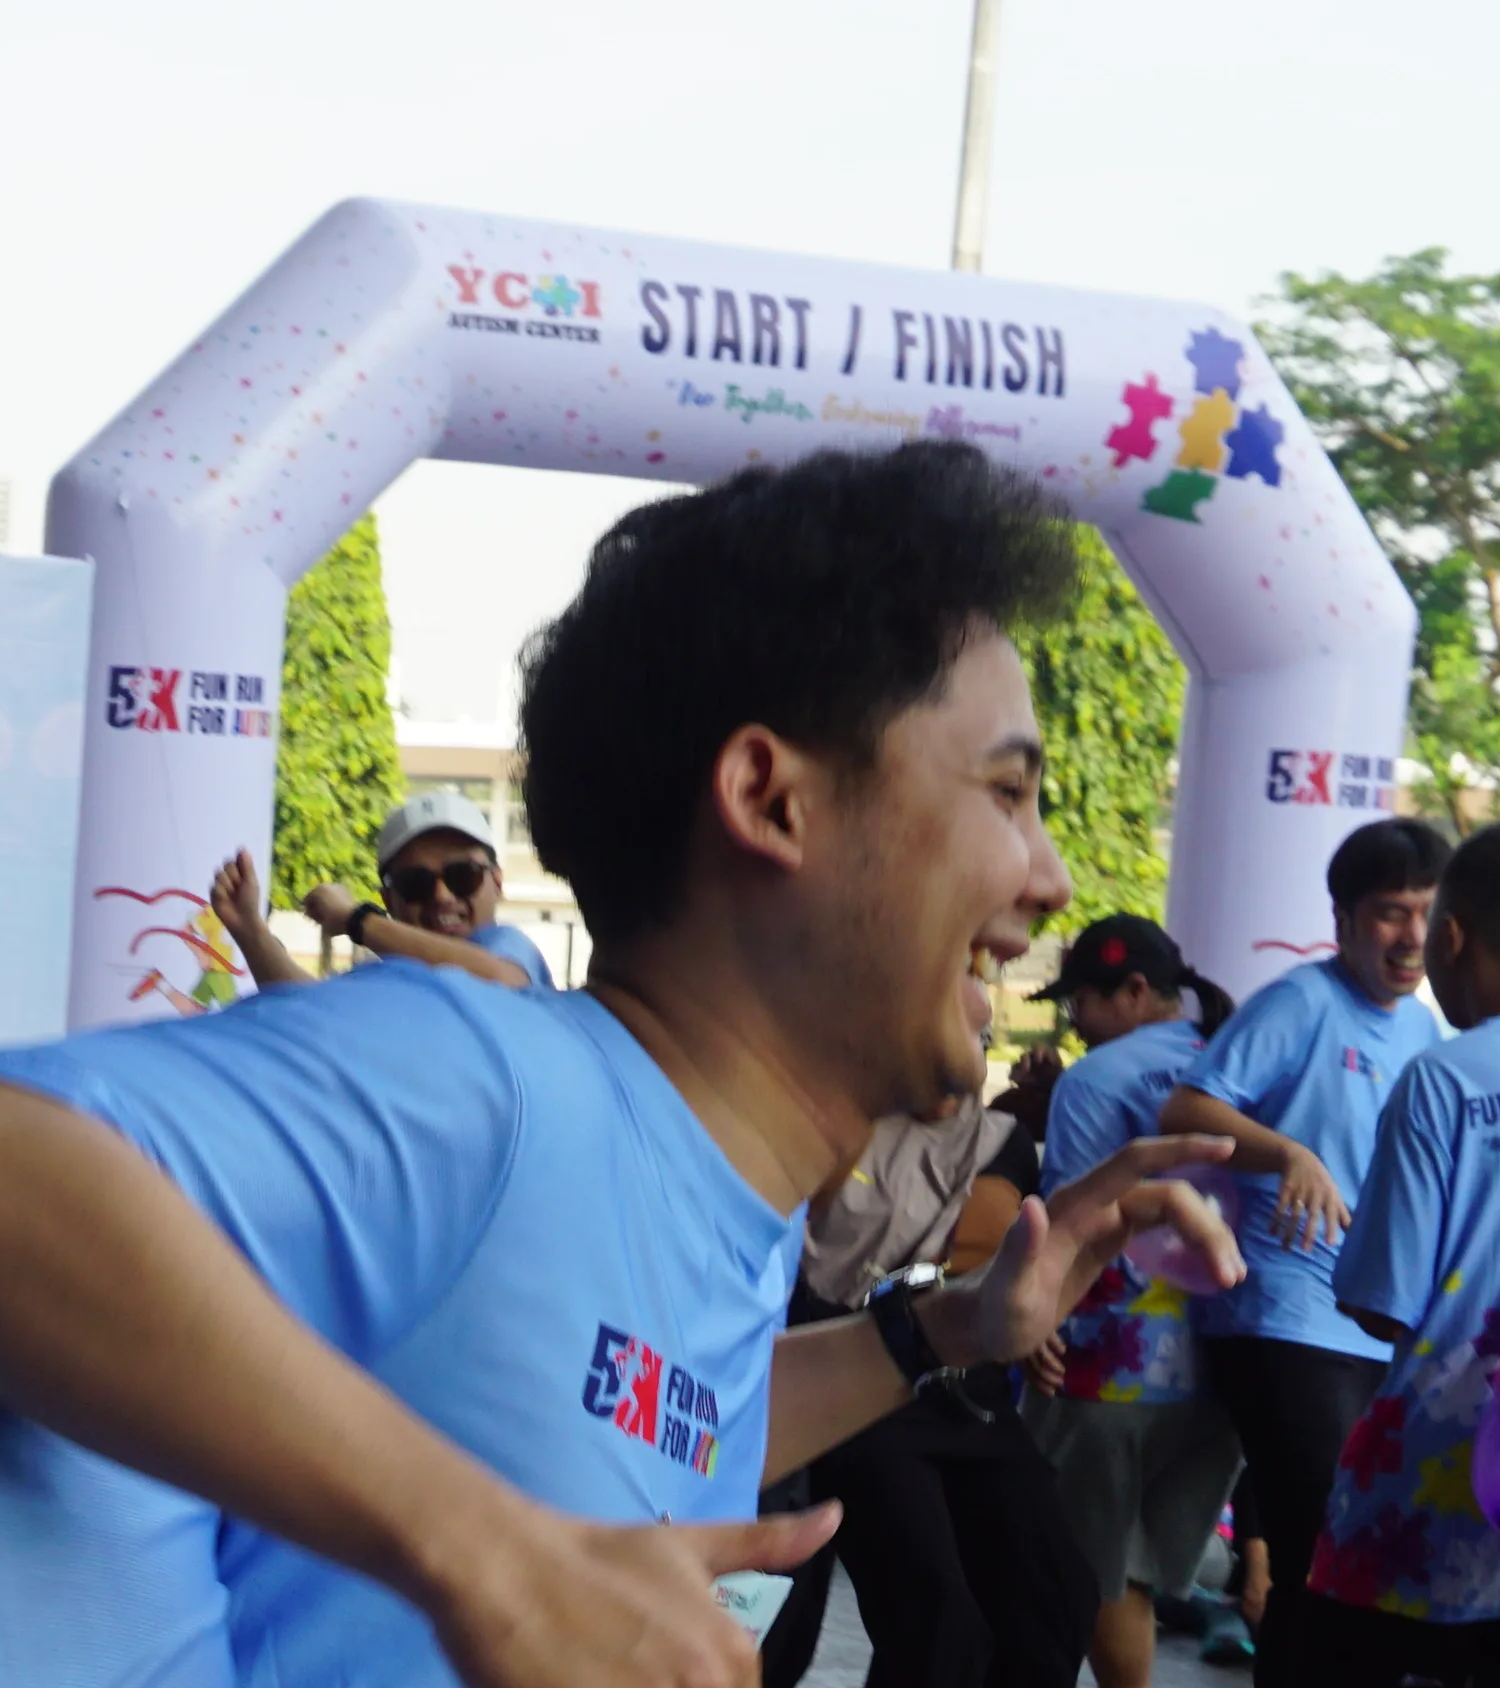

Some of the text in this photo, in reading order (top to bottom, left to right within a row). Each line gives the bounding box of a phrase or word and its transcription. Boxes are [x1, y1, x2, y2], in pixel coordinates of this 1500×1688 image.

[447, 264, 602, 318] YCI
[449, 312, 601, 345] AUTISM CENTER
[639, 279, 1068, 399] START / FINISH
[190, 672, 264, 703] FUN RUN
[186, 703, 228, 736] FOR
[666, 1362, 719, 1431] FUN RUN
[661, 1414, 690, 1467] FOR
